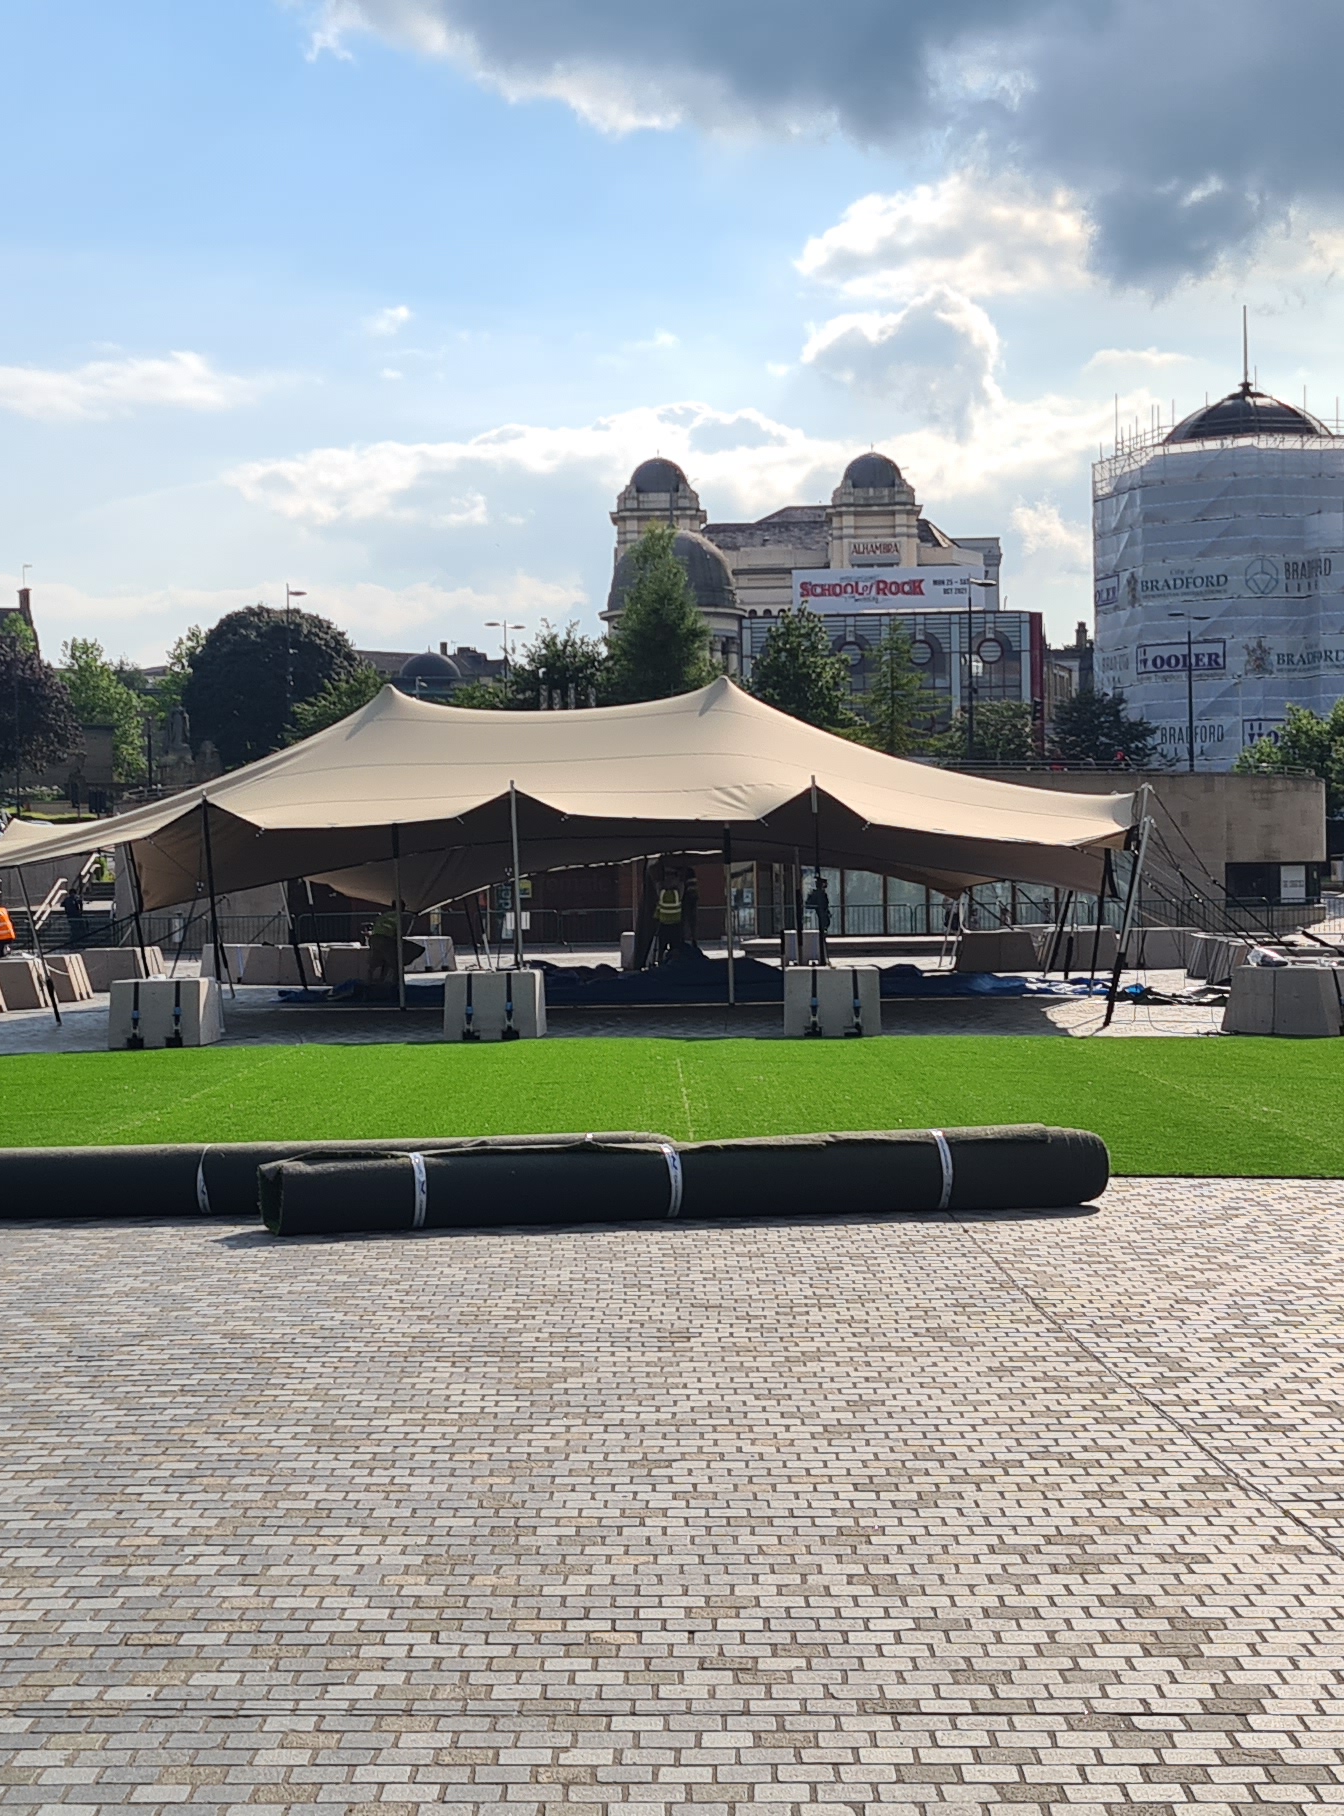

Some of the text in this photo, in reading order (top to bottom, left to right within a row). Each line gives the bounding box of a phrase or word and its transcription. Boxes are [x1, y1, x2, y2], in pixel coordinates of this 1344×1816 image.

[851, 542, 899, 554] ALHAMBRA
[800, 579, 925, 597] SCHOOL of ROCK
[1141, 574, 1228, 592] BRADFORD
[1160, 725, 1224, 744] BRADFORD
